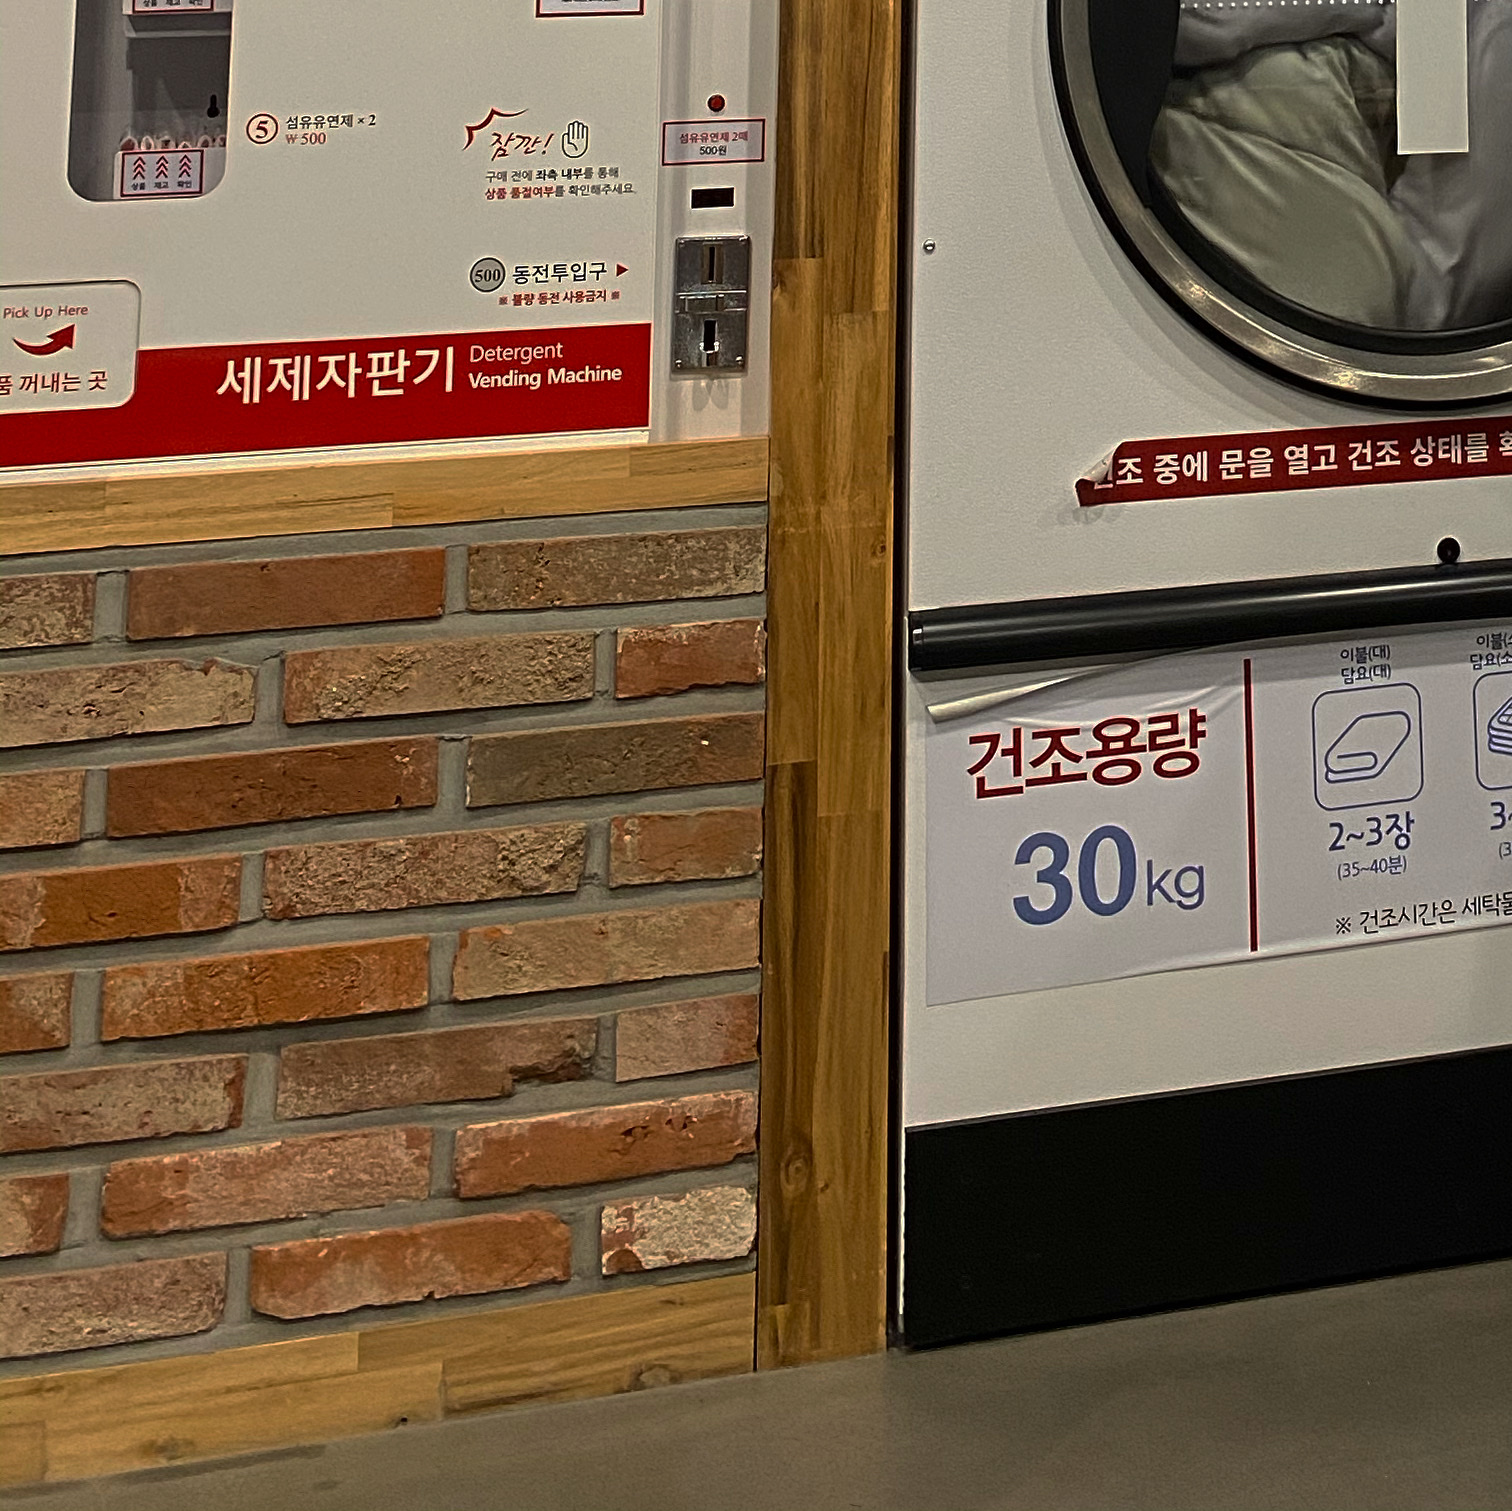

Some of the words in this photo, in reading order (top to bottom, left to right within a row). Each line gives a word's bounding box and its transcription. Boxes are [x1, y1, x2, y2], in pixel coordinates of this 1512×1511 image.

[285, 113, 354, 129] 섬유유연제
[699, 144, 727, 156] 500원
[474, 269, 500, 283] 500
[512, 262, 608, 285] 동전투입구
[537, 291, 560, 305] 동전
[562, 289, 607, 304] 사용금지
[3, 307, 29, 319] Pick
[34, 306, 53, 320] Up
[58, 305, 89, 317] Here
[469, 342, 564, 367] Detergent
[19, 371, 82, 395] 꺼내는
[216, 345, 457, 405] 세제자판기
[469, 368, 541, 391] Vending
[547, 363, 623, 386] Machine
[1153, 451, 1208, 485] 중에
[1218, 446, 1274, 481] 문을
[1283, 443, 1339, 476] 열고
[1347, 439, 1401, 471] 건조
[1410, 431, 1490, 467] 상태를
[1340, 644, 1391, 665] 이불(대)
[1341, 663, 1392, 685] 담요(대)
[966, 707, 1208, 800] 건조용량
[1328, 811, 1415, 852] 2~3장
[1338, 856, 1408, 881] (35~40분)
[1359, 899, 1457, 935] 건조시간은
